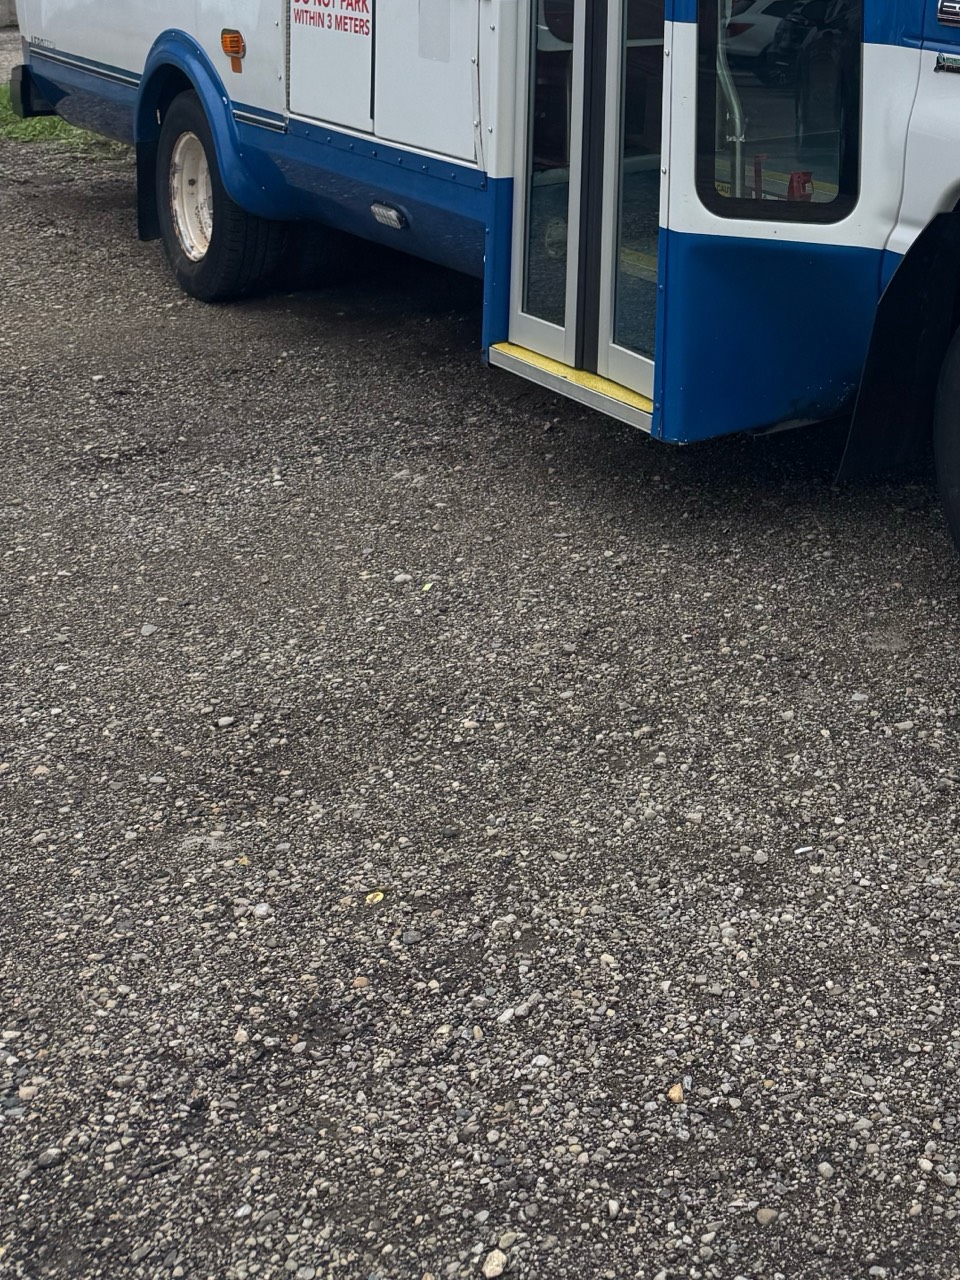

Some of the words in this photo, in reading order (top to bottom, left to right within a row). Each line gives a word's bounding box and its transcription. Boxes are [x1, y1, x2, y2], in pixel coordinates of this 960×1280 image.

[294, 8, 325, 28] WITHIN
[327, 13, 333, 30] 3
[335, 14, 370, 36] METERS
